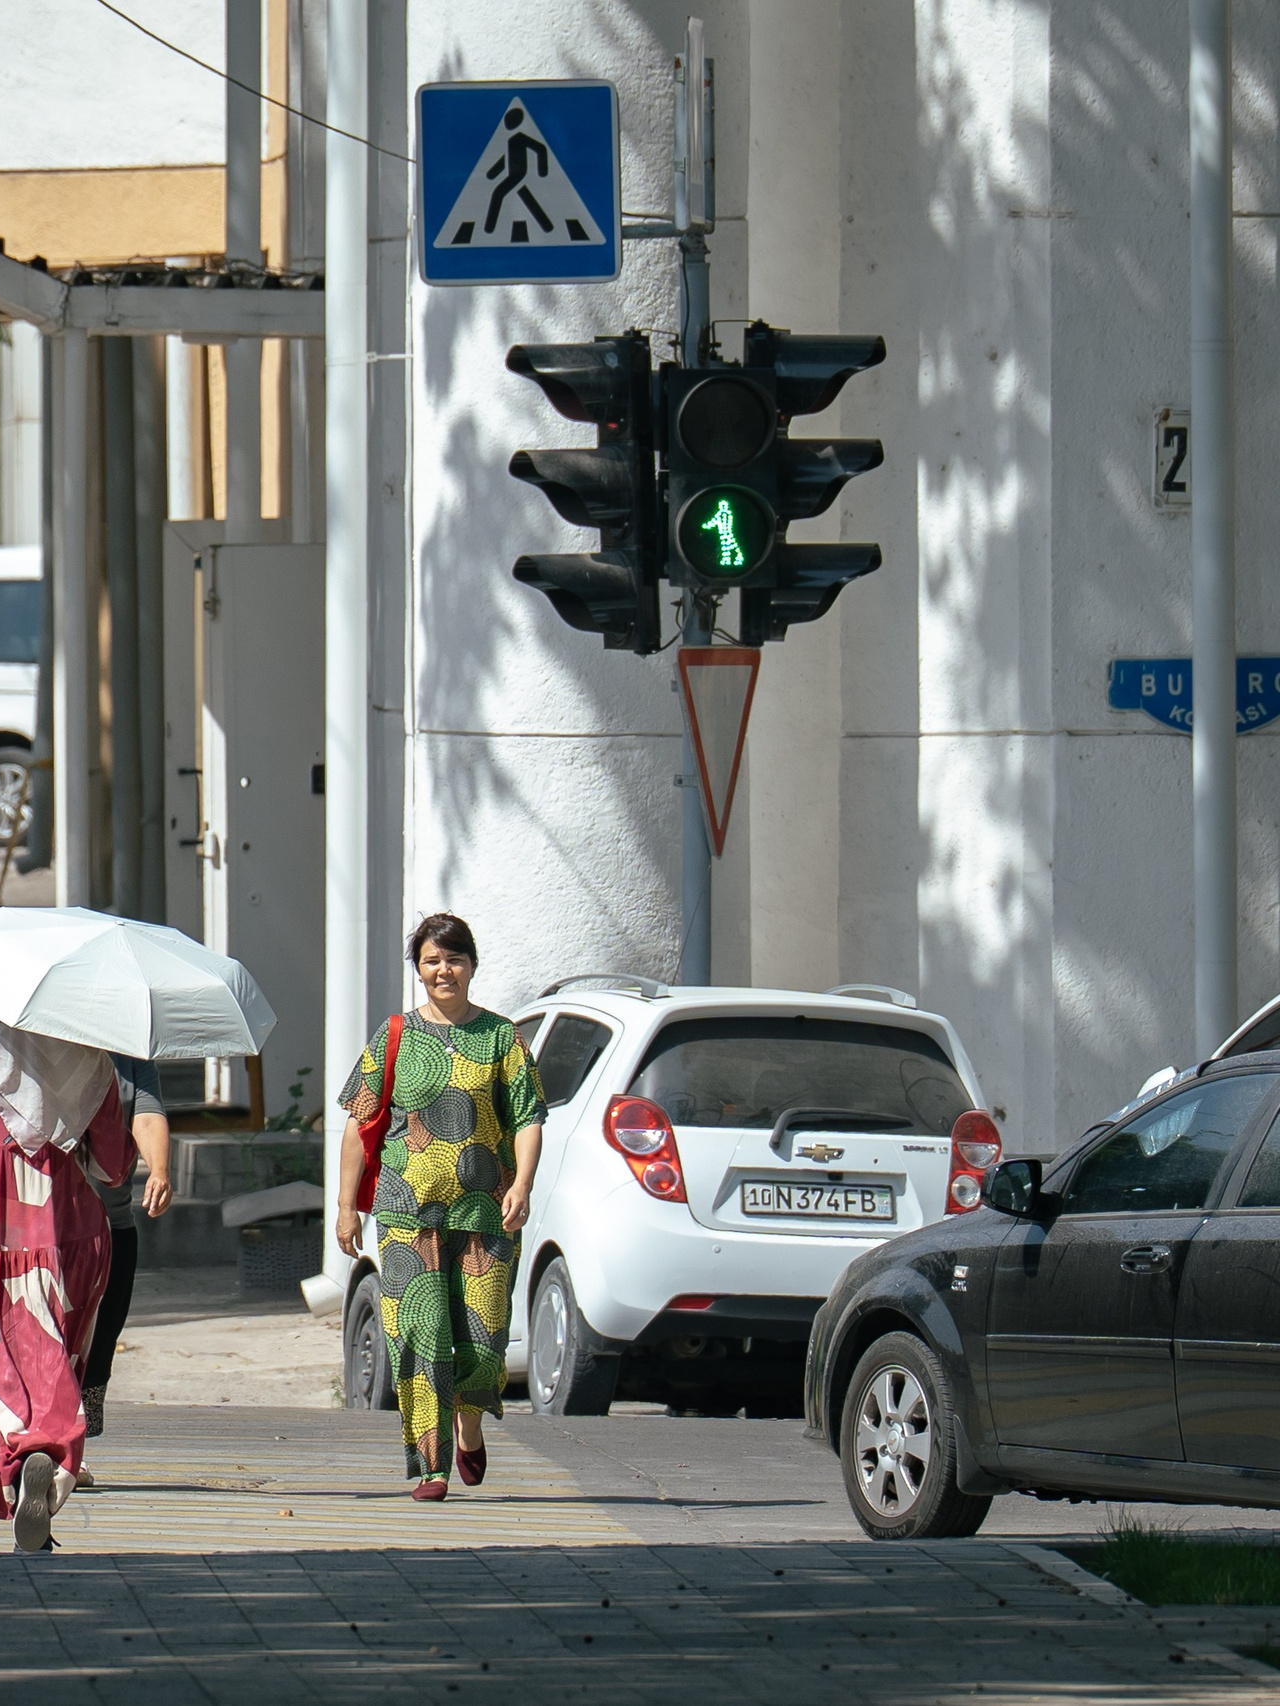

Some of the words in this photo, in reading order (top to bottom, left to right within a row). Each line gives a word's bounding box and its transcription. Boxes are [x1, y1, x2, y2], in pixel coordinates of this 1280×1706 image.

[1162, 427, 1188, 492] 2
[1141, 673, 1280, 697] BUR
[749, 1188, 772, 1206] 10
